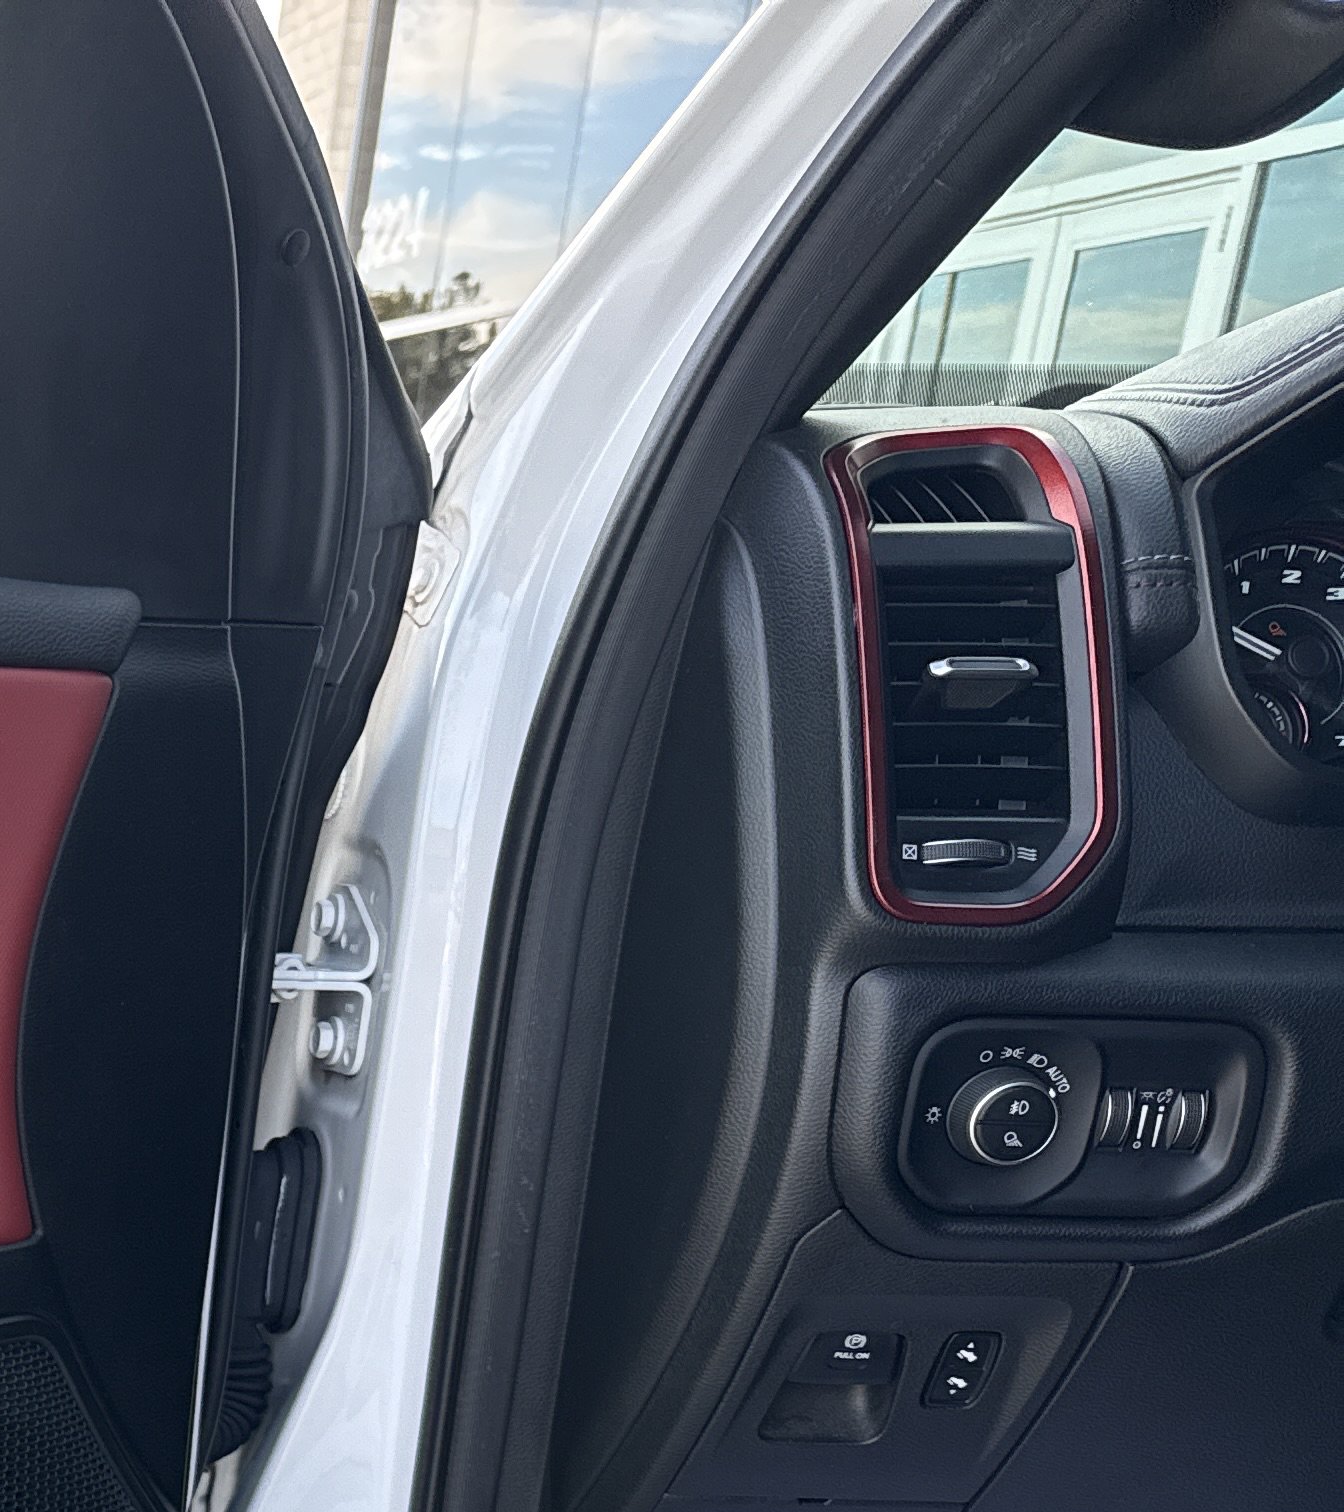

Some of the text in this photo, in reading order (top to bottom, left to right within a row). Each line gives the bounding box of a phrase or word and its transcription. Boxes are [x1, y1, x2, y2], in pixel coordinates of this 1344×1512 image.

[1281, 569, 1302, 584] 2
[1240, 580, 1251, 595] 1
[1046, 1066, 1071, 1094] AUTO
[833, 1351, 870, 1360] PULL ON
